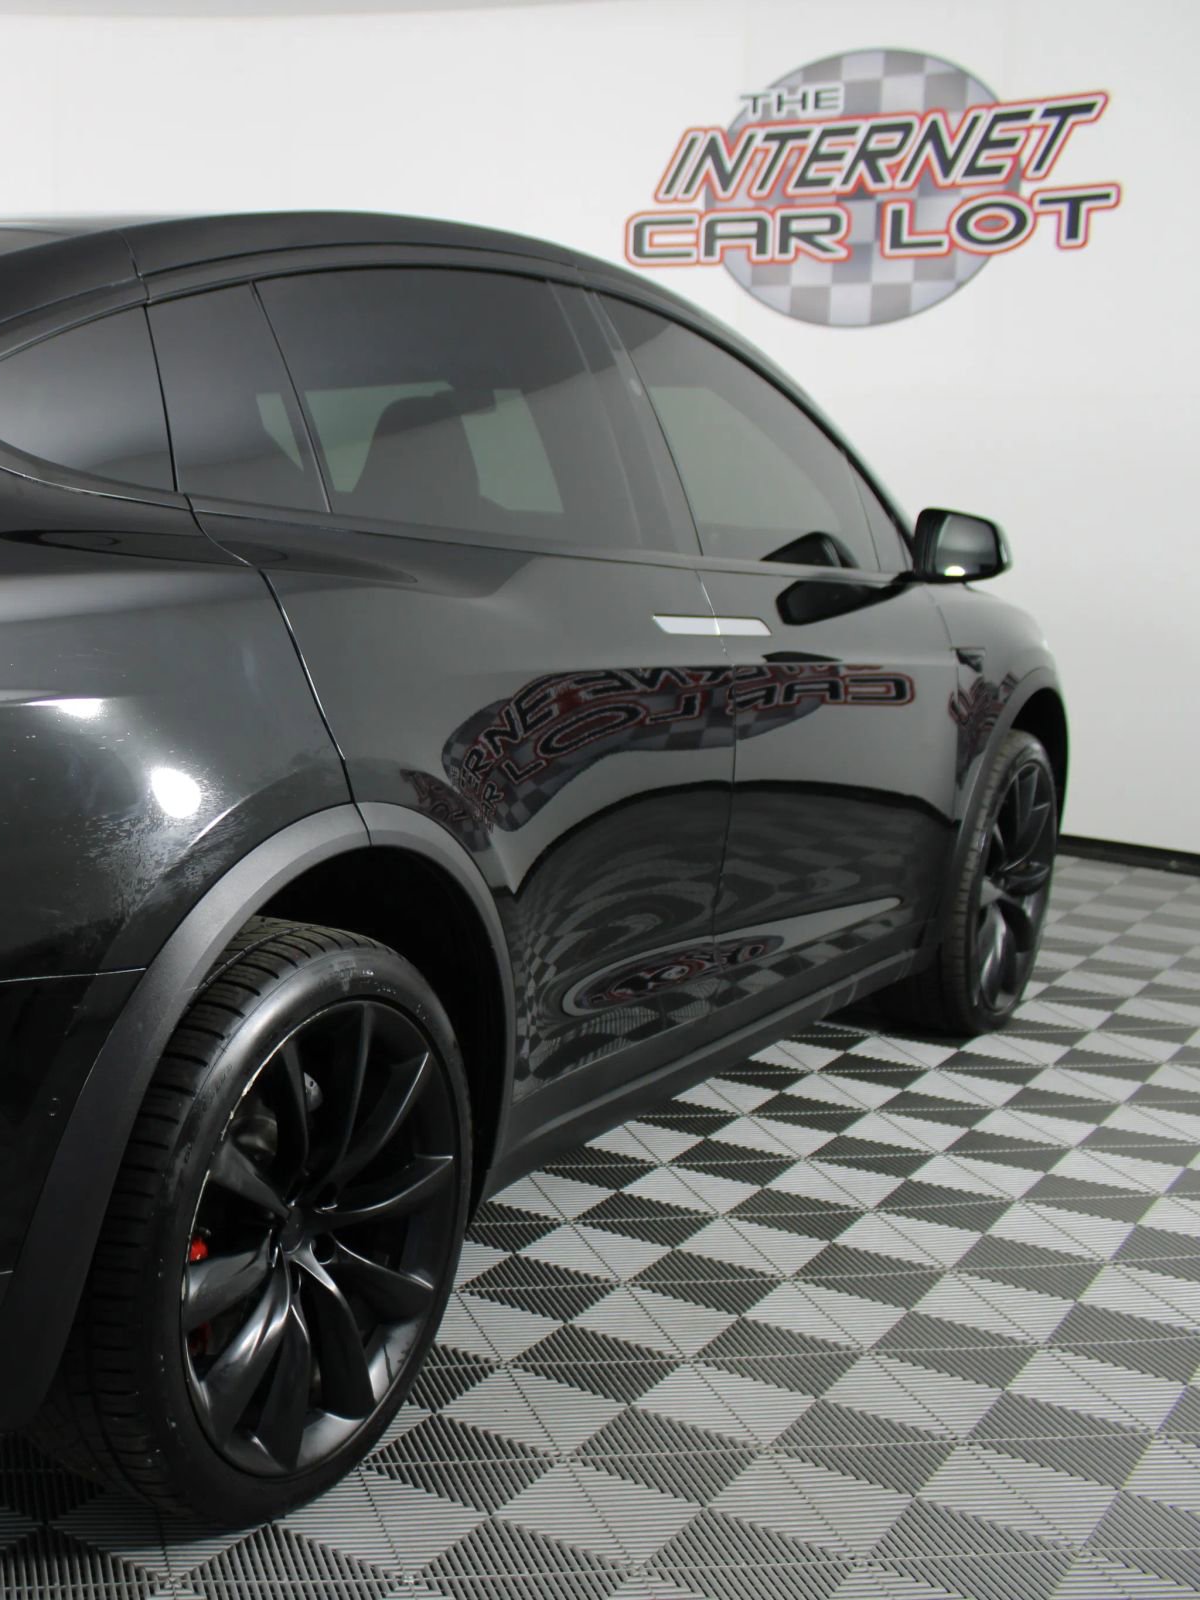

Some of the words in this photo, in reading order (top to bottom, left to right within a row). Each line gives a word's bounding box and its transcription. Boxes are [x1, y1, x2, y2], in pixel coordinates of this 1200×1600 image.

[738, 84, 844, 118] THE
[657, 92, 1107, 202] INTERNET
[627, 206, 851, 266] CAR
[881, 184, 1120, 260] LOT
